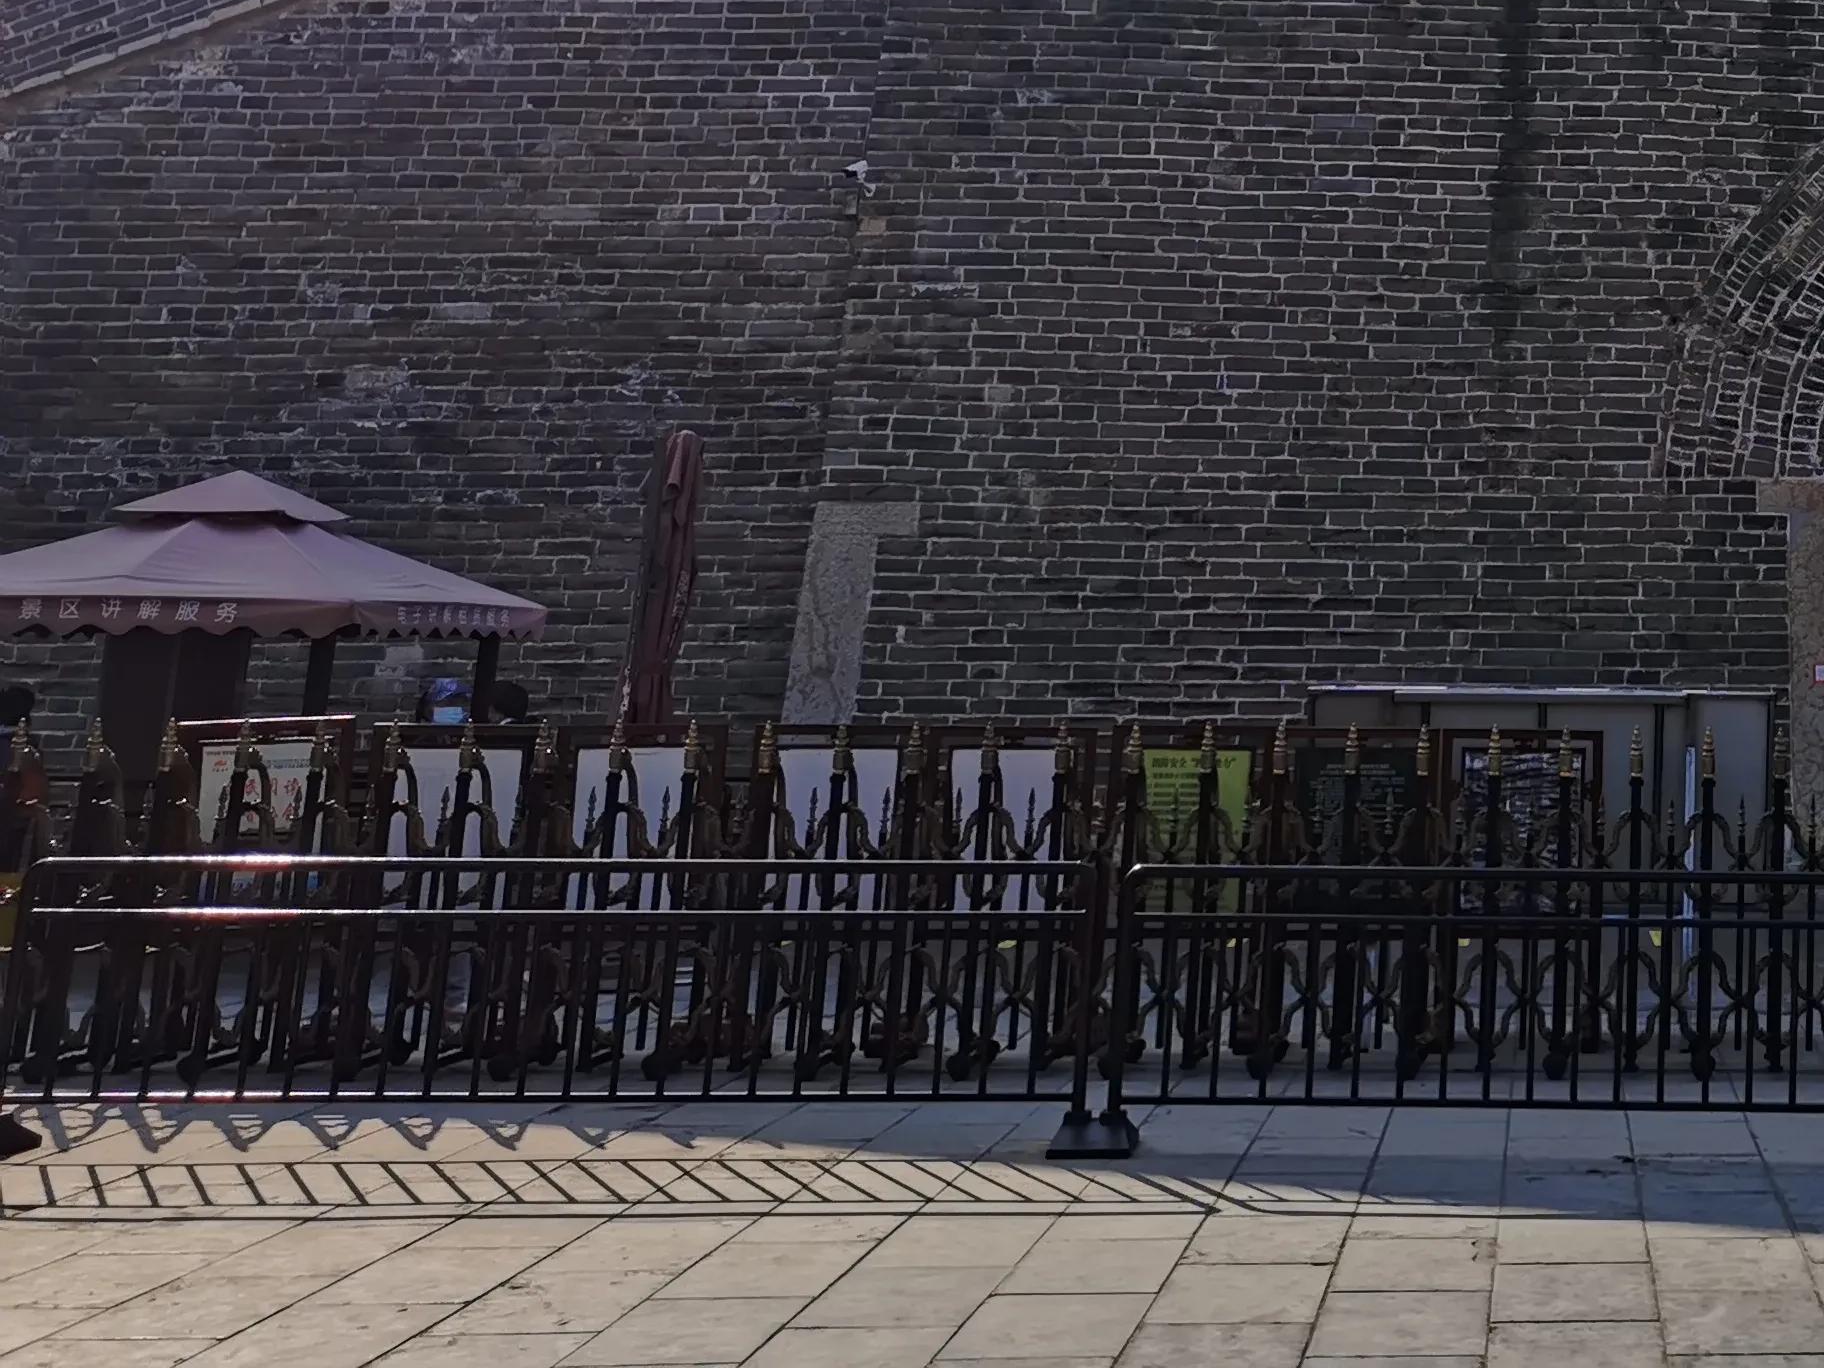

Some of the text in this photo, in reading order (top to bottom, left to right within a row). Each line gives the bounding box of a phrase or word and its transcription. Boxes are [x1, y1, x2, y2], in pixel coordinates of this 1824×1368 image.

[18, 598, 241, 623] 景区讲解服务
